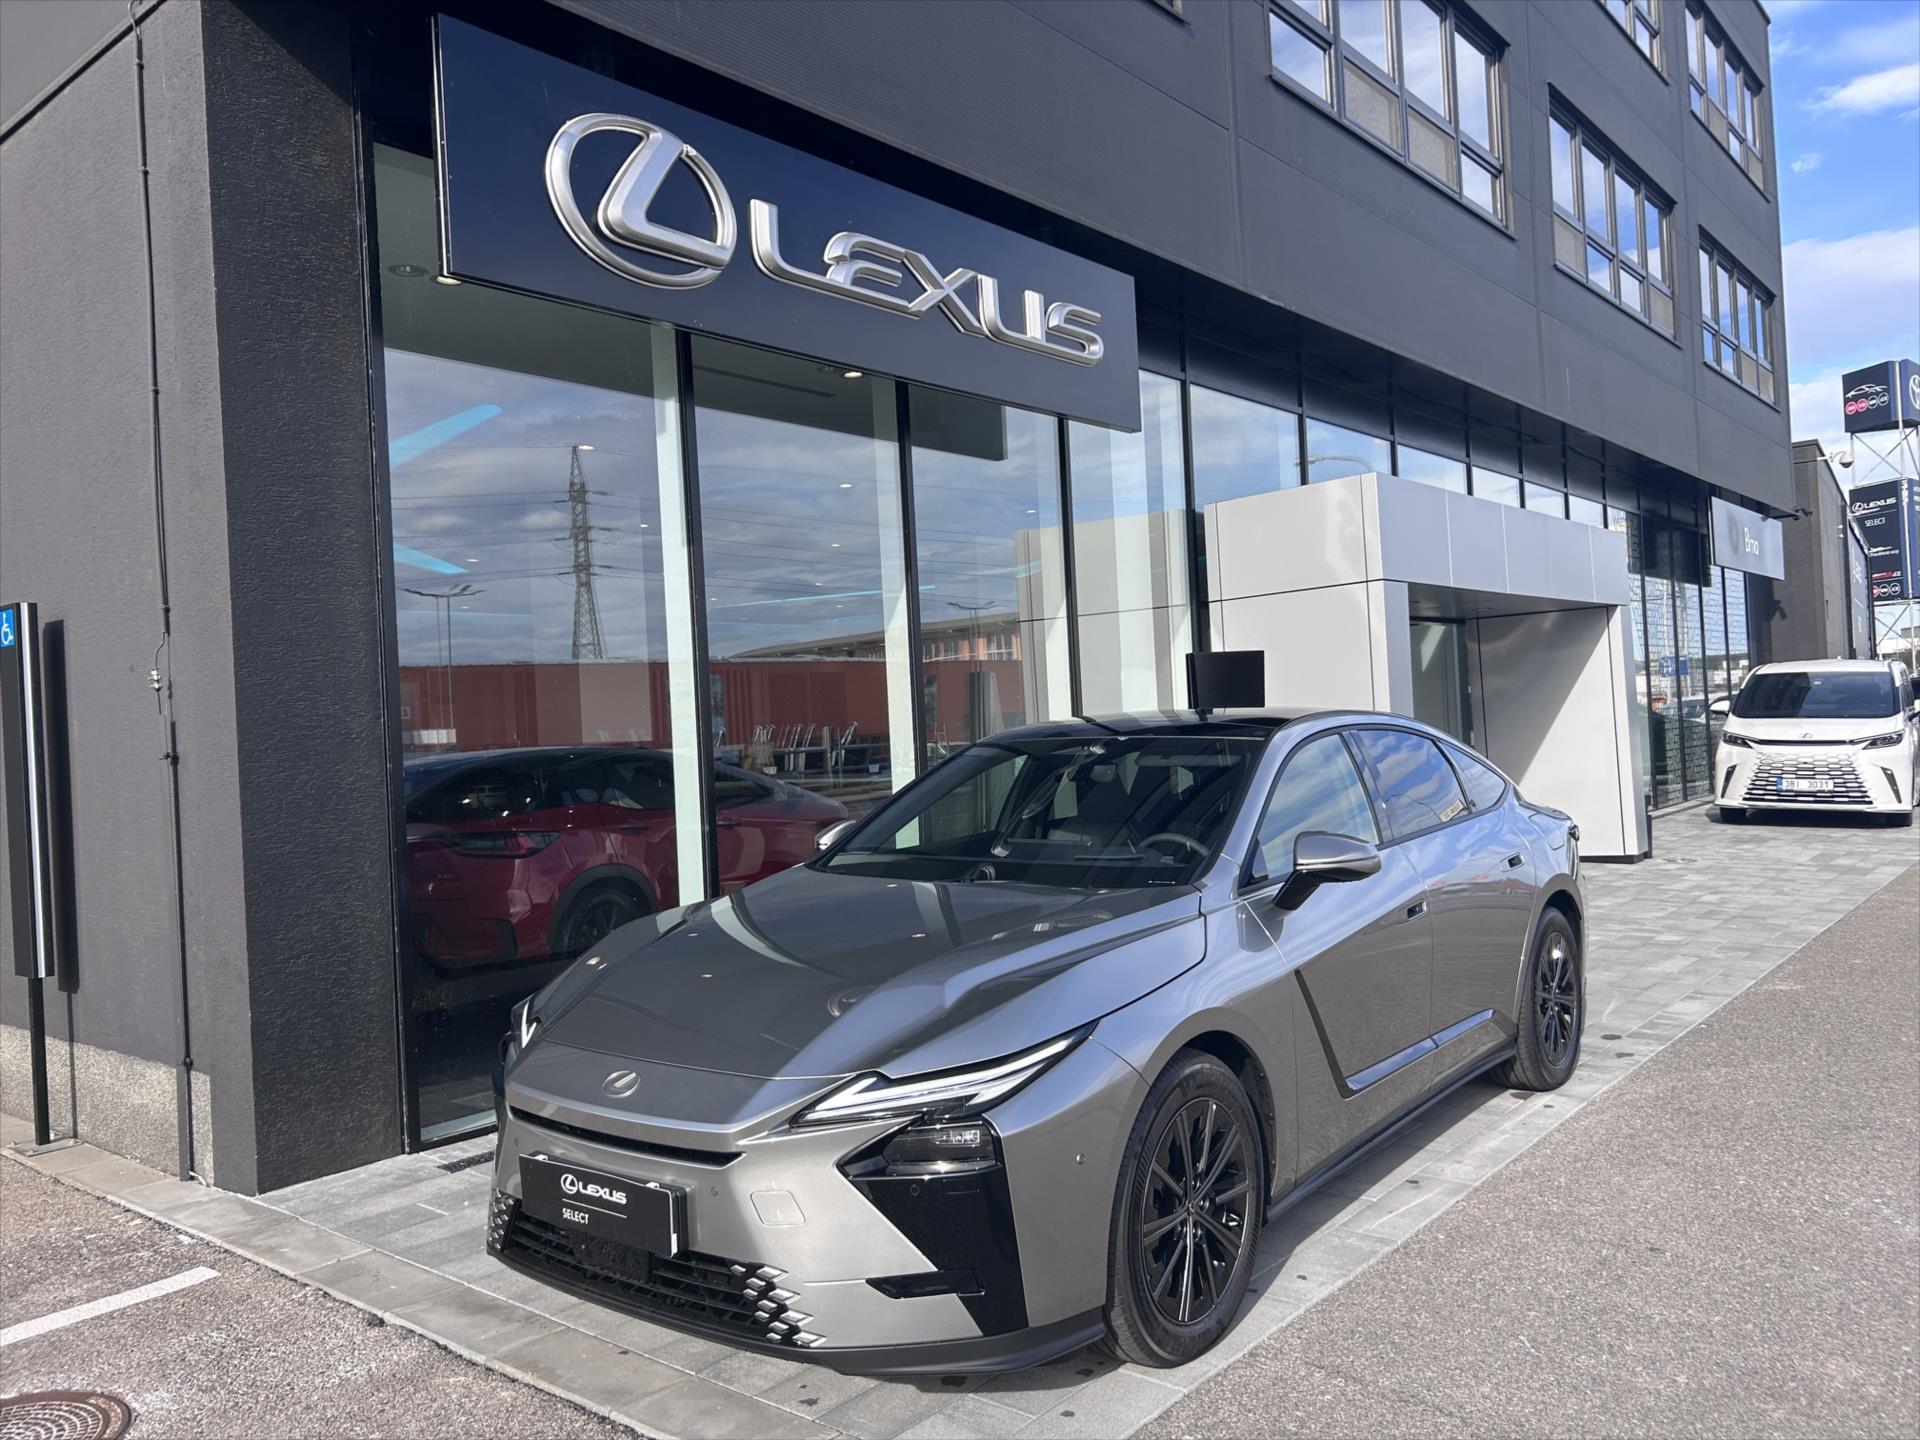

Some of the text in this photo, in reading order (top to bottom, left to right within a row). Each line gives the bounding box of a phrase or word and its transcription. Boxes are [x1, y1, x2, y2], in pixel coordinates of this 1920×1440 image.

[749, 198, 1104, 367] LEXUS
[1863, 497, 1897, 509] LEXUS
[1864, 517, 1886, 527] SELECT
[578, 1181, 628, 1205] LEXUS
[562, 1207, 589, 1225] SELECT
